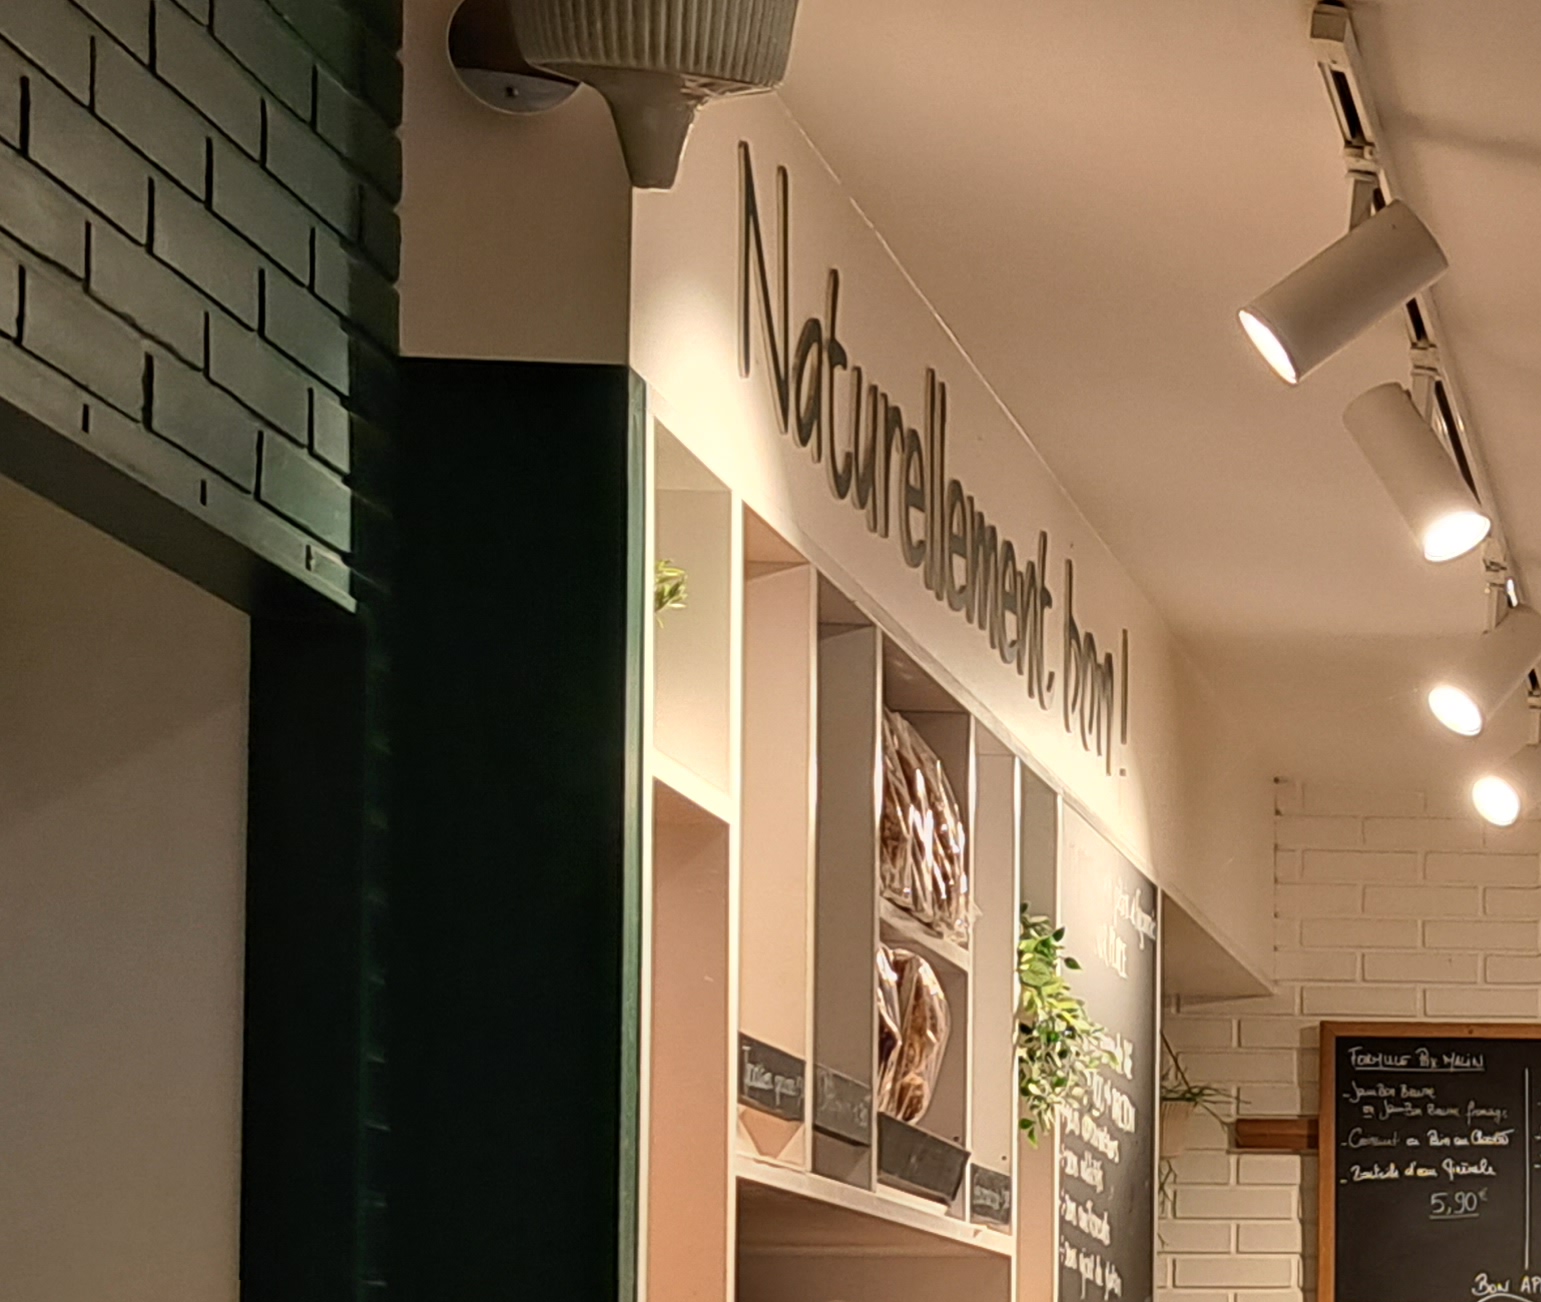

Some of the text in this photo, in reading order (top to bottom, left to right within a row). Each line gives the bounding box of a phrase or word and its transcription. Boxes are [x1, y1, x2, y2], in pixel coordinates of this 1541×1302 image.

[737, 140, 1056, 711] Naturellement
[1064, 558, 1115, 777] bon
[1471, 1272, 1511, 1296] BON
